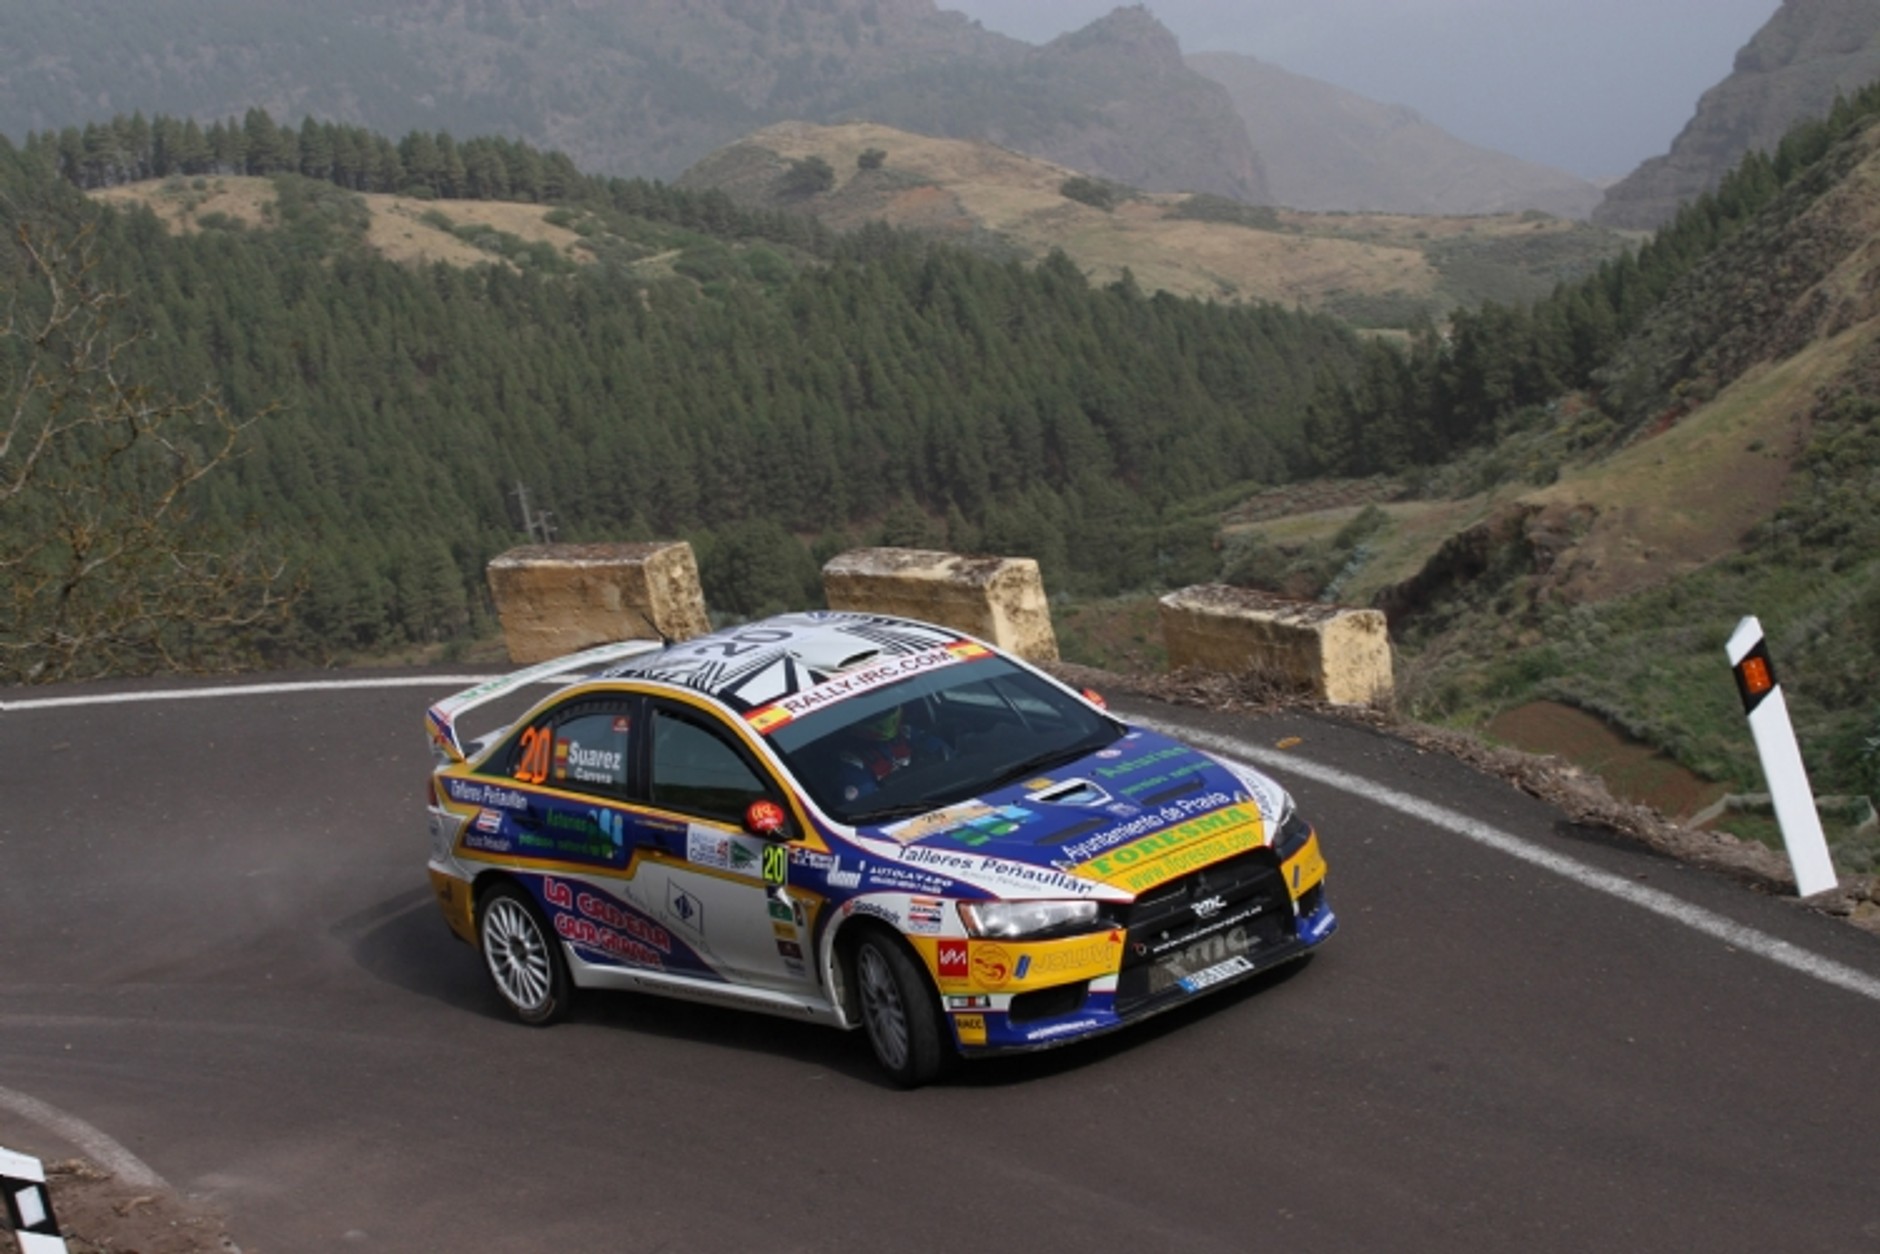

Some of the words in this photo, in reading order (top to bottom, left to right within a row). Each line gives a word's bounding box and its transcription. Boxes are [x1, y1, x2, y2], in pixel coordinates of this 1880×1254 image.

[514, 726, 552, 784] 20
[568, 740, 623, 770] Suarez
[1061, 812, 1164, 861] Ayuntamiento
[1088, 806, 1251, 876] FORESMA
[763, 846, 784, 883] 20
[898, 847, 976, 873] Talleres
[543, 874, 573, 910] LA
